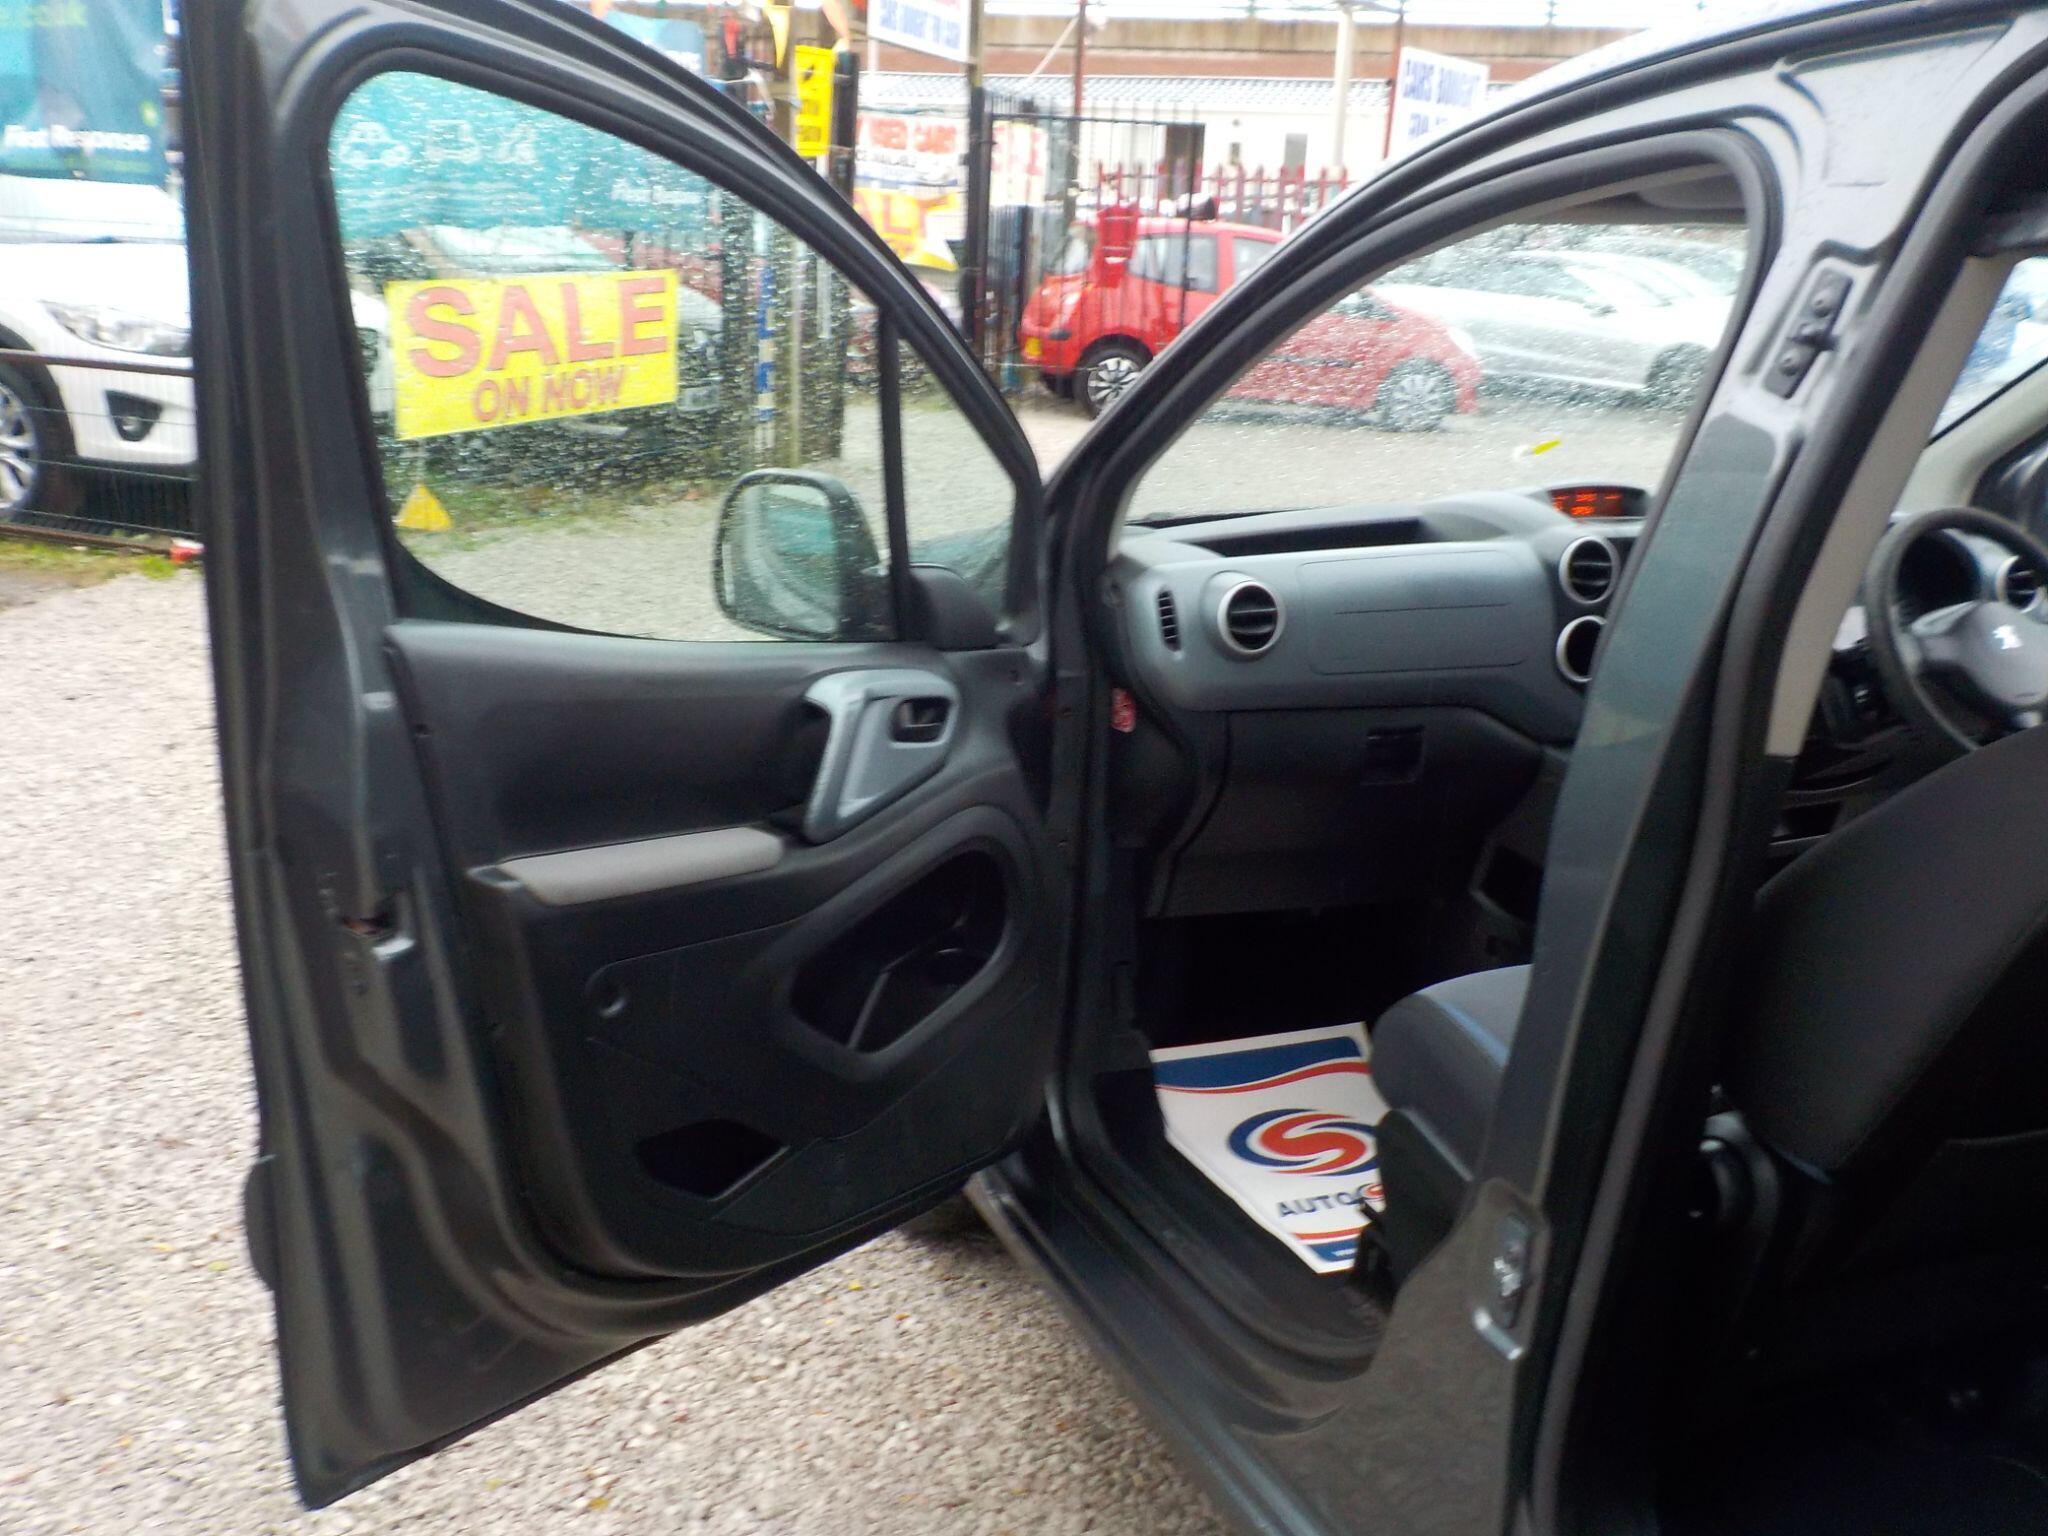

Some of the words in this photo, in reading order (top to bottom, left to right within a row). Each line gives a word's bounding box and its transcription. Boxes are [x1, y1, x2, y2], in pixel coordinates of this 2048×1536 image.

[407, 277, 668, 378] SALE
[472, 376, 530, 422] ON
[541, 364, 626, 414] NOW
